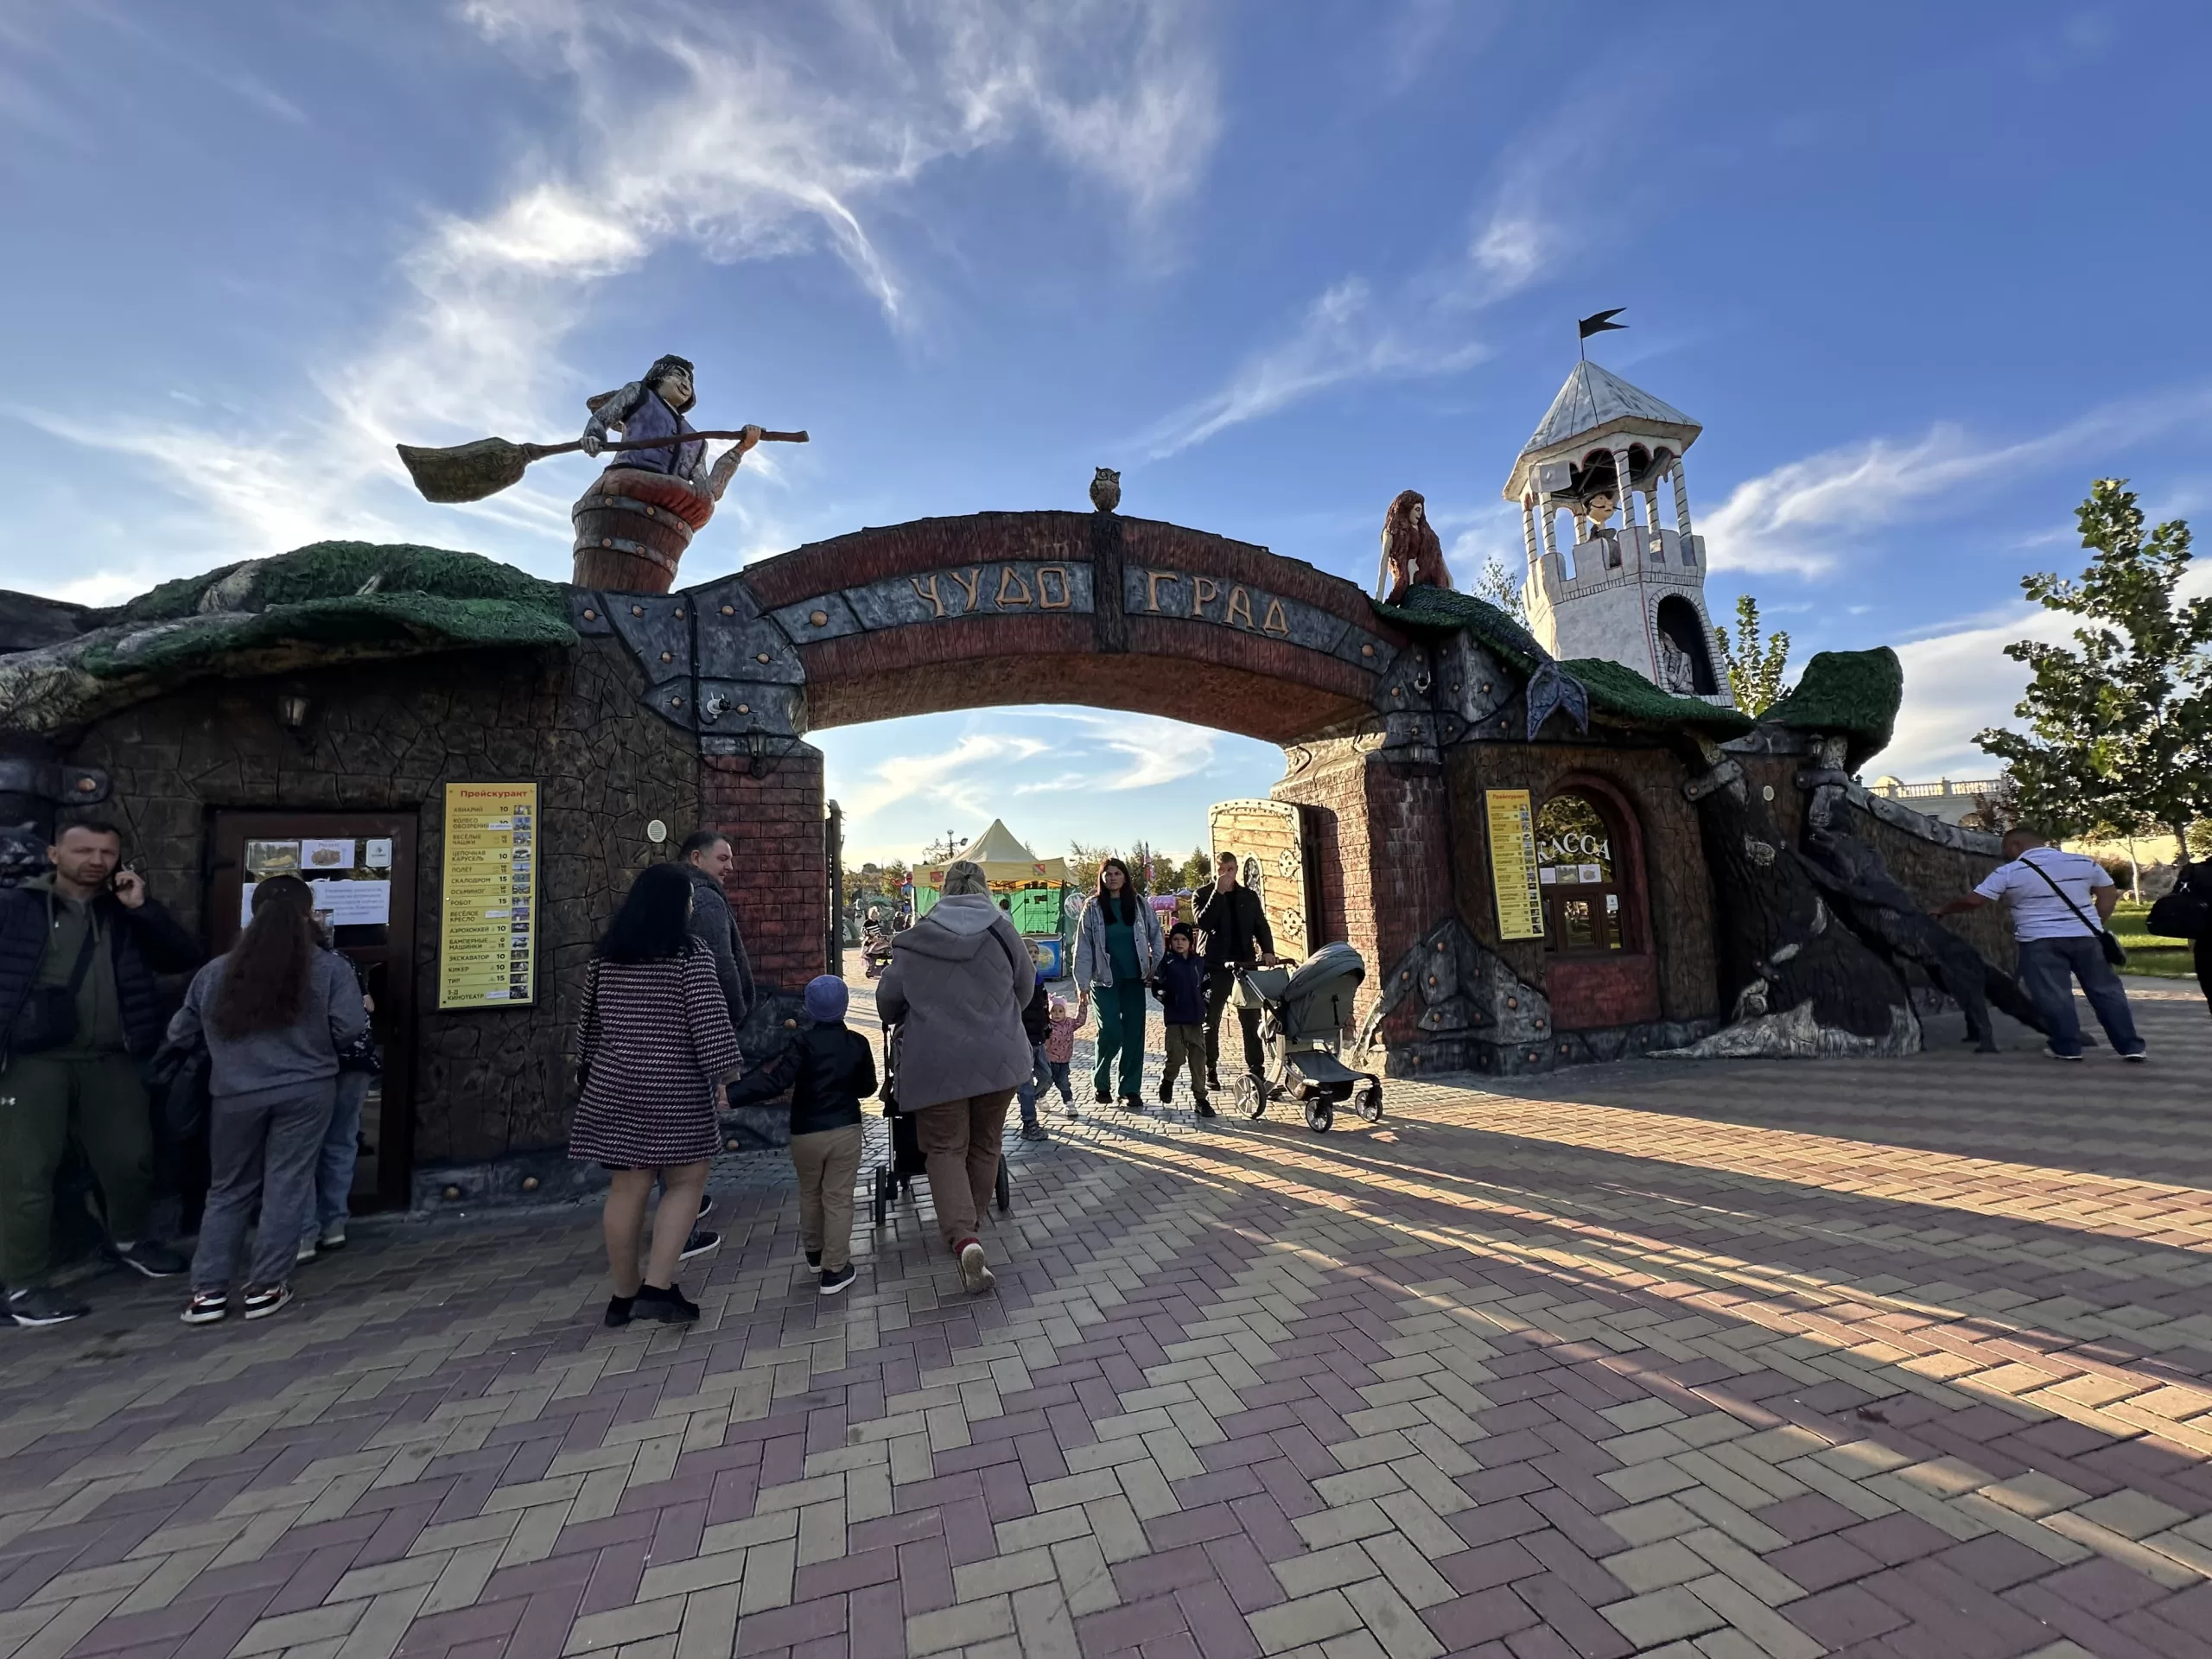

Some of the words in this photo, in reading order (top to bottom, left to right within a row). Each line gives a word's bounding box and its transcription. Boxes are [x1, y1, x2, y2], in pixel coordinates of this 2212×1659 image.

[909, 566, 1071, 618] ЧУДО
[1145, 570, 1290, 637] ГРАД
[461, 789, 527, 798] Прейскурант
